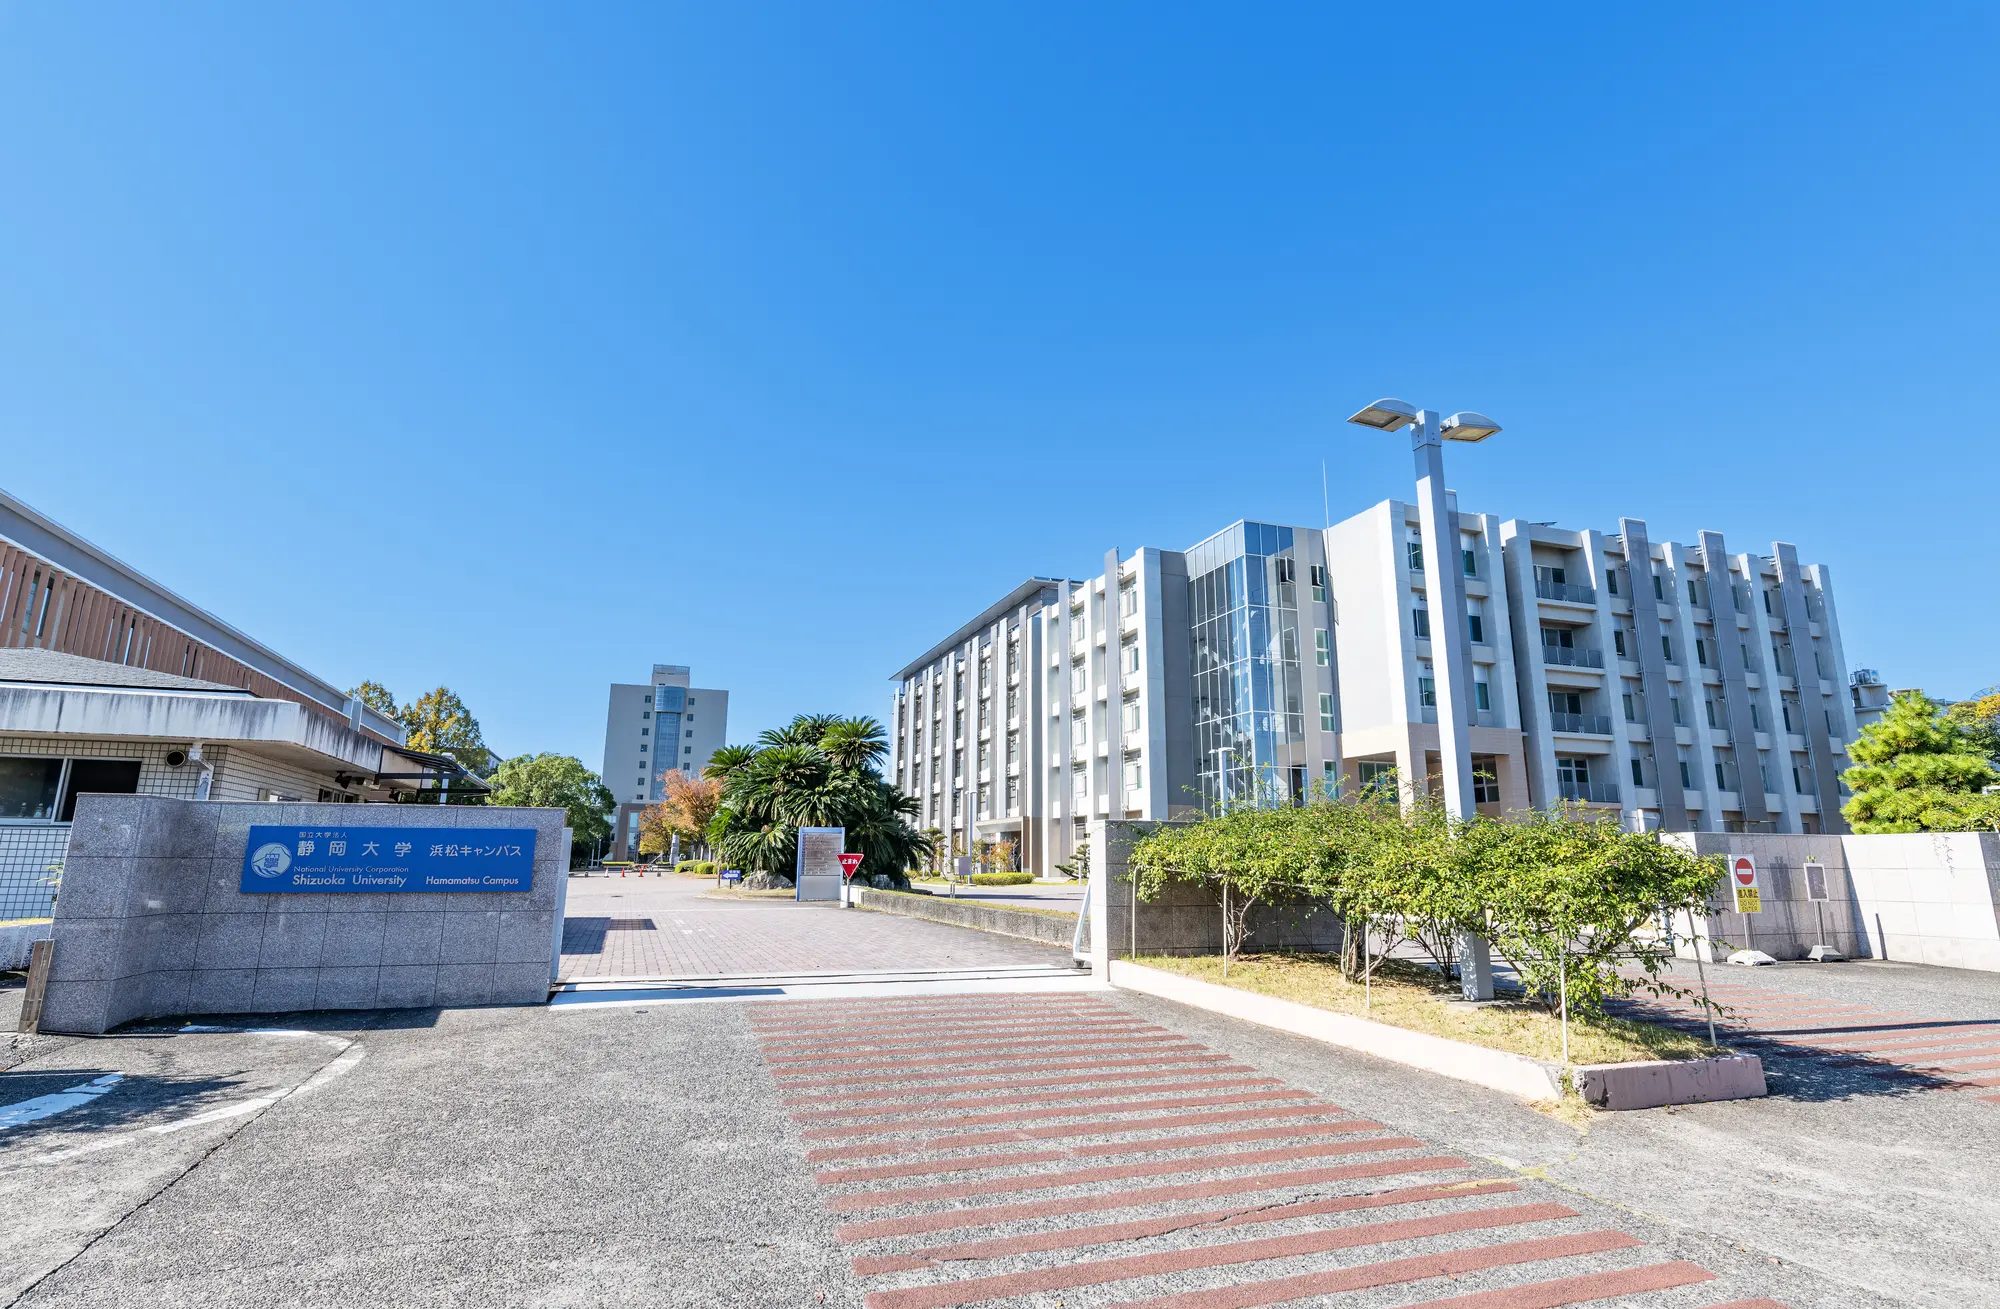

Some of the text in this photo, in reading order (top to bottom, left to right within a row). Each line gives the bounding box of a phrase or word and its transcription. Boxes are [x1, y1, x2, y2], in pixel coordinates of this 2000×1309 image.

[298, 831, 348, 839] 国立大学法人
[297, 840, 522, 858] 静岡大学 浜松キャンパス
[293, 865, 409, 874] National University Corporation
[292, 874, 519, 888] Shizuoka University Hamamatsu Campus
